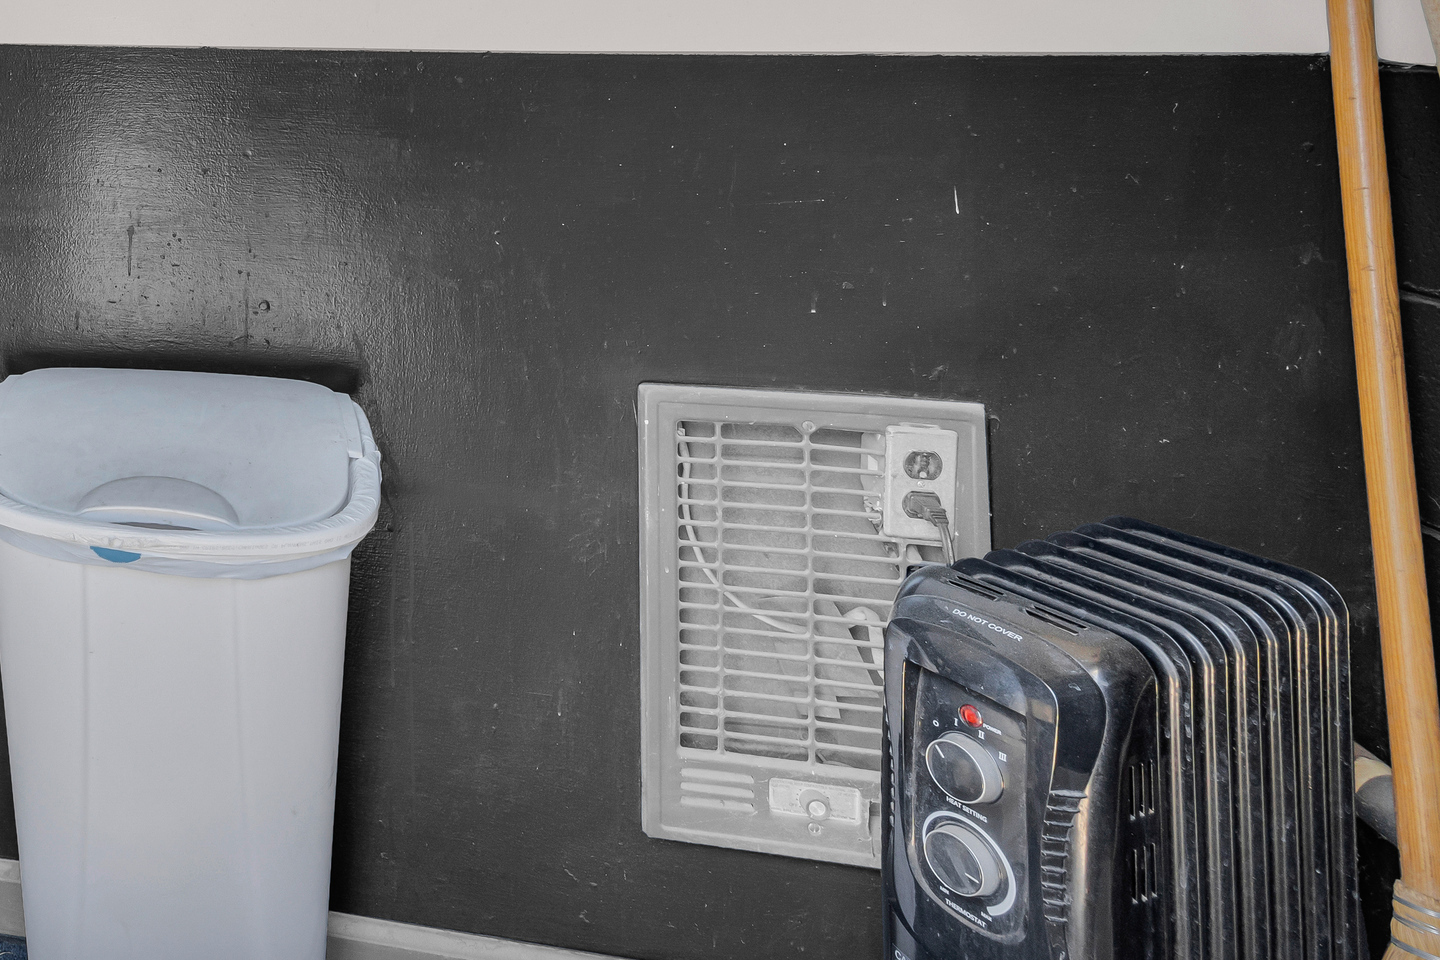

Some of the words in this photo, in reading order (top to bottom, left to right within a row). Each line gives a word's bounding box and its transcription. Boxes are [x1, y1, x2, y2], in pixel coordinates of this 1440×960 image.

[952, 608, 968, 617] DO
[966, 614, 989, 626] NOT
[987, 623, 1023, 642] COVER
[982, 722, 1002, 736] POWER
[946, 795, 962, 809] HEAT
[962, 804, 988, 824] SETTING
[945, 897, 987, 929] THERMOSTAT
